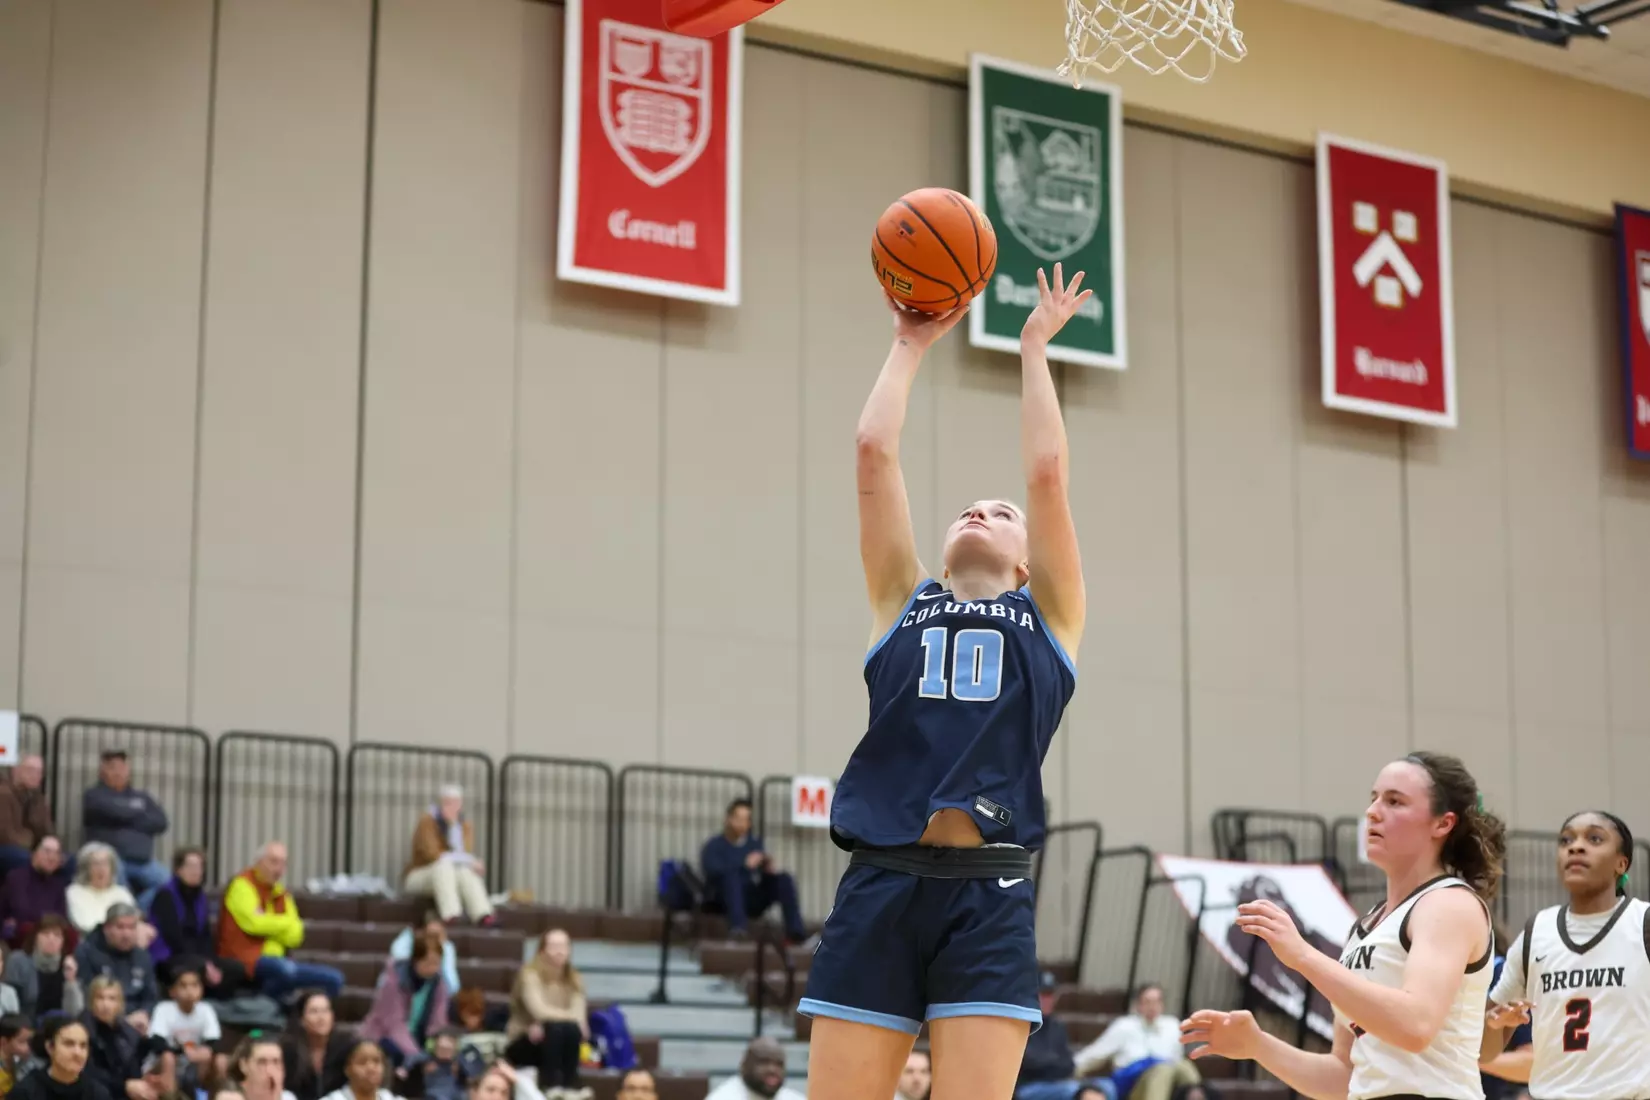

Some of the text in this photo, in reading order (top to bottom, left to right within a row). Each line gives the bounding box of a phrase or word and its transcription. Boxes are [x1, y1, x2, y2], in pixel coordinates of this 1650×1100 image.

[902, 601, 1035, 631] COLUMBIA
[918, 626, 1005, 702] 10
[798, 785, 826, 817] M
[1541, 967, 1625, 994] BROWN
[1563, 998, 1592, 1052] 2
